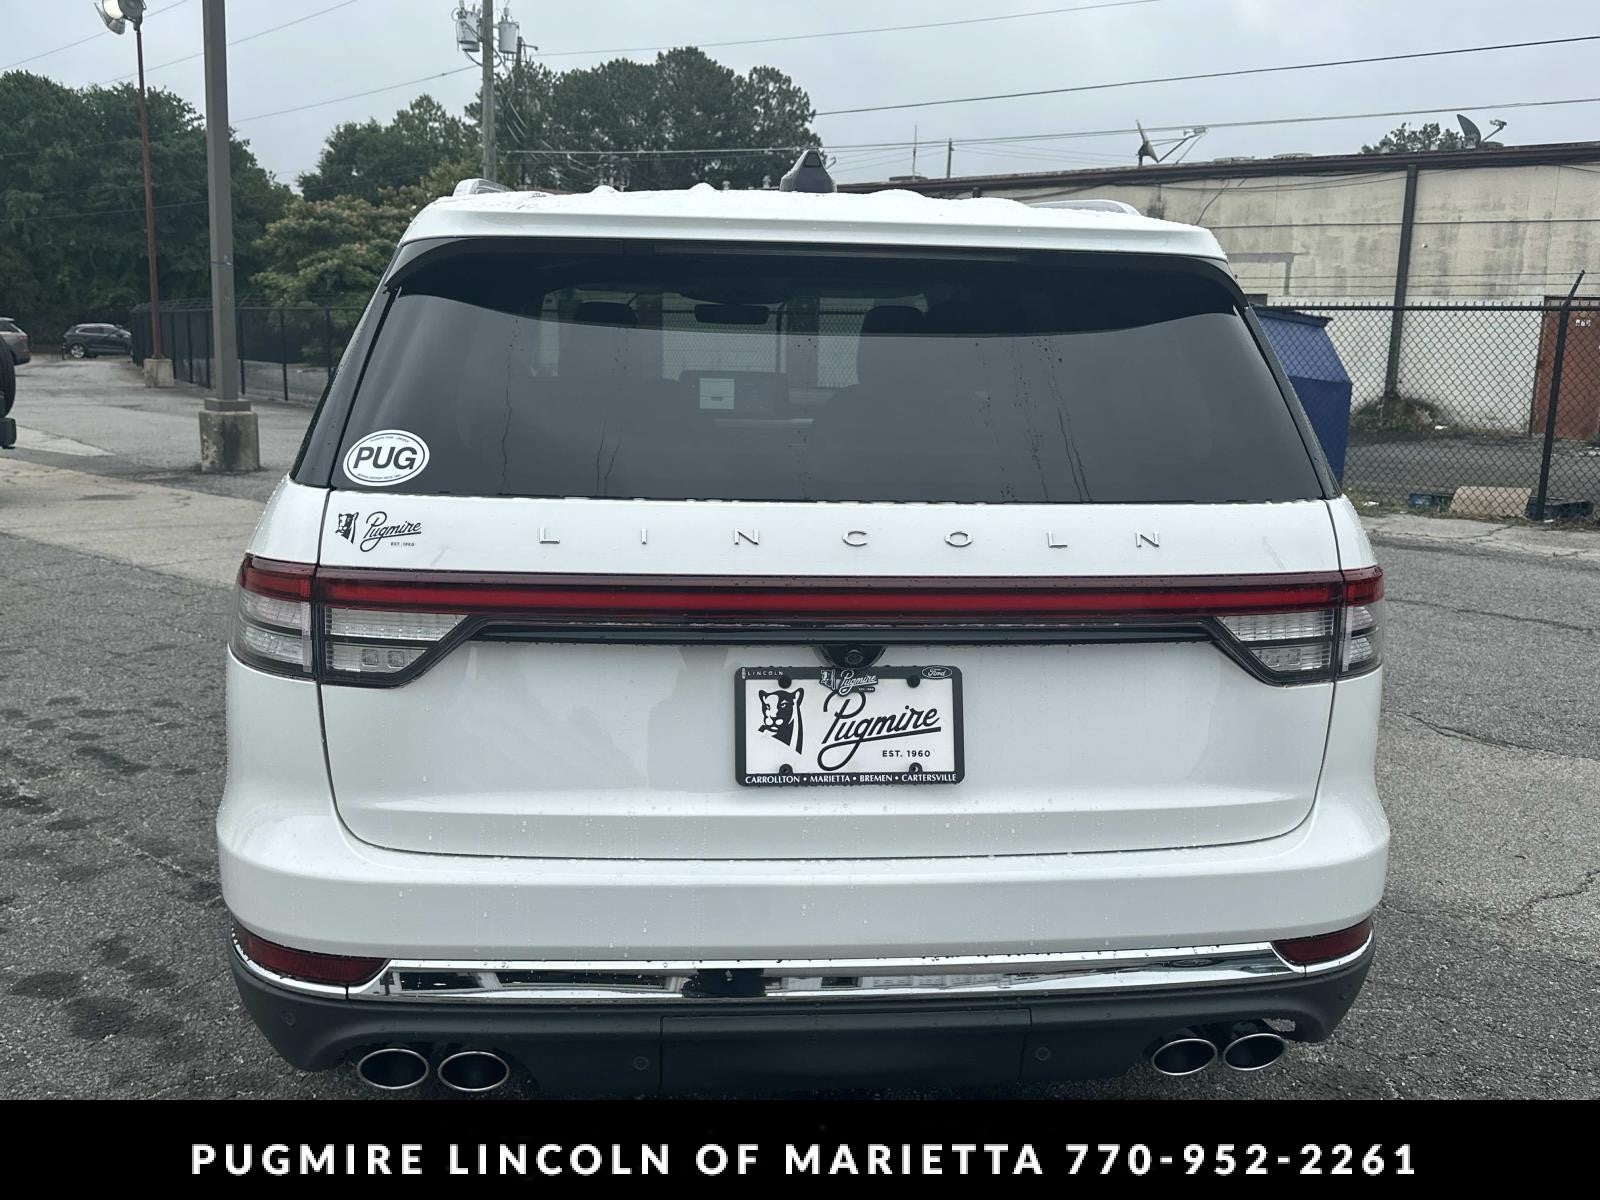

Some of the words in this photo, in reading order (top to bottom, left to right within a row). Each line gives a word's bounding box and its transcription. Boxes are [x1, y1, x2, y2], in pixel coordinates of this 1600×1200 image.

[353, 446, 418, 470] PUG
[360, 511, 422, 552] Pugmire
[538, 526, 1161, 549] LINCOLN
[839, 669, 878, 696] Pugmire
[817, 688, 942, 771] Pugmire
[882, 750, 903, 758] EST.
[906, 750, 931, 758] 1960
[745, 775, 800, 784] CARROLLTON
[809, 775, 850, 783] MARIETTA
[859, 774, 893, 783] BREMEN
[901, 773, 957, 782] CARTERSVILLE
